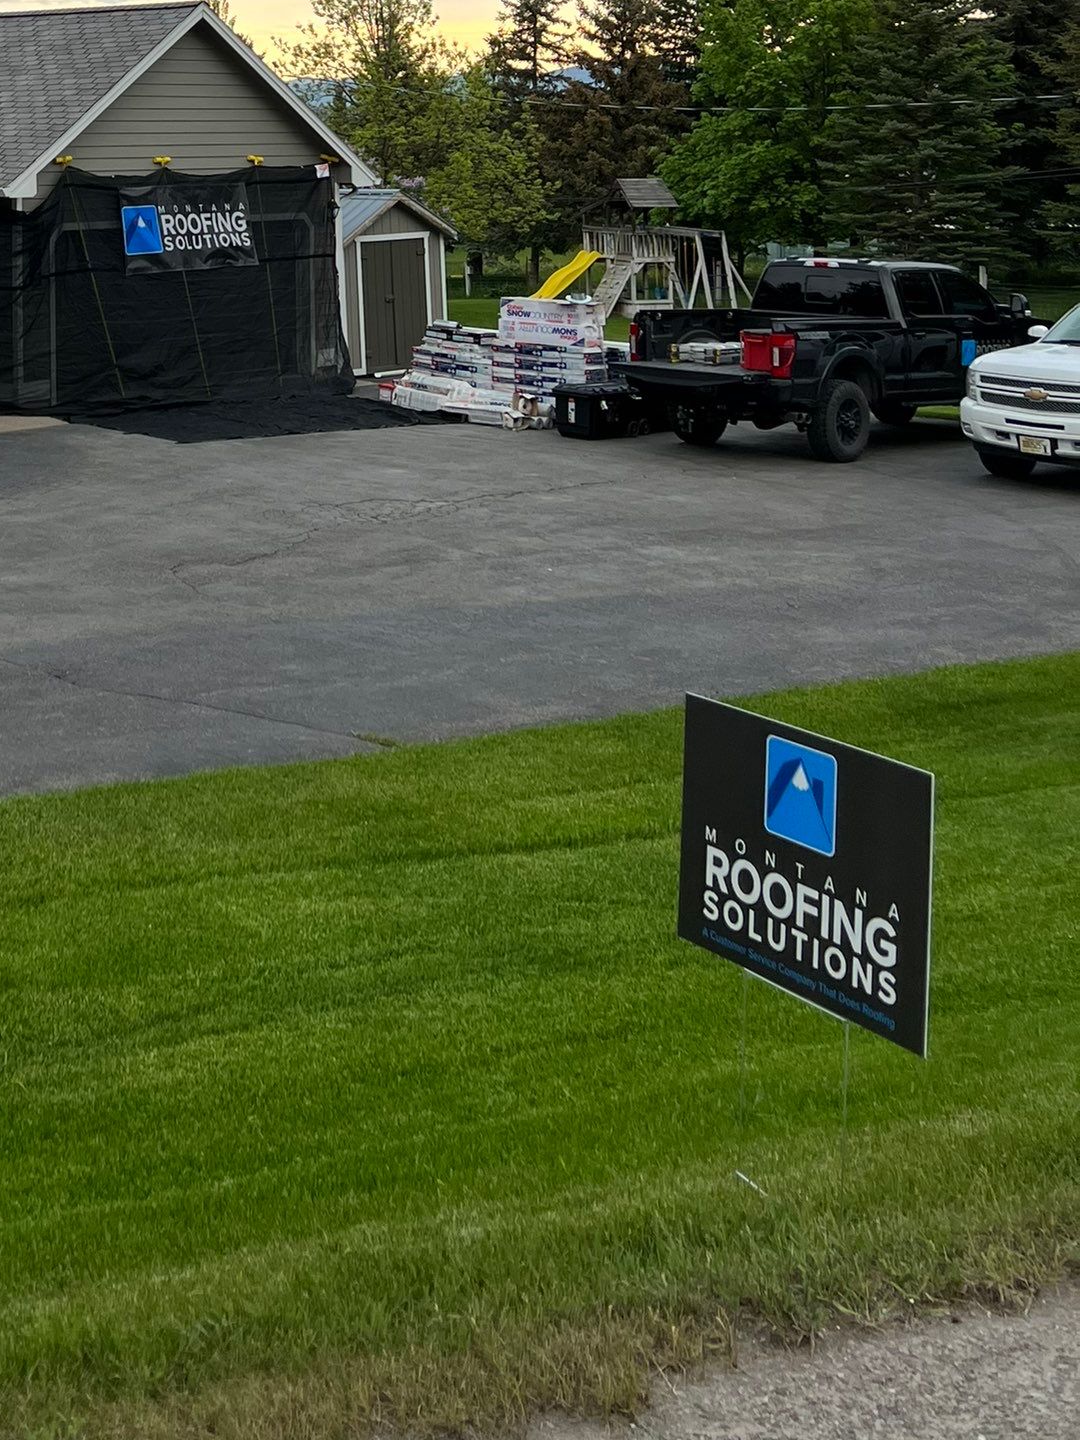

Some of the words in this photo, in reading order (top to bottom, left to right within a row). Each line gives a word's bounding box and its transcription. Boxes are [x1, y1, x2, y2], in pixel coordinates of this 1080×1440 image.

[158, 202, 245, 212] MONTANA
[160, 211, 247, 236] ROOFING
[164, 232, 251, 251] SOLUTIONS
[705, 824, 900, 922] MONTANA
[705, 844, 897, 968] ROOFING
[703, 889, 897, 1005] SOLUTIONS
[778, 962, 816, 991] Company
[820, 981, 837, 1000] That
[838, 991, 861, 1013] Does
[862, 1002, 896, 1032] Roofing
